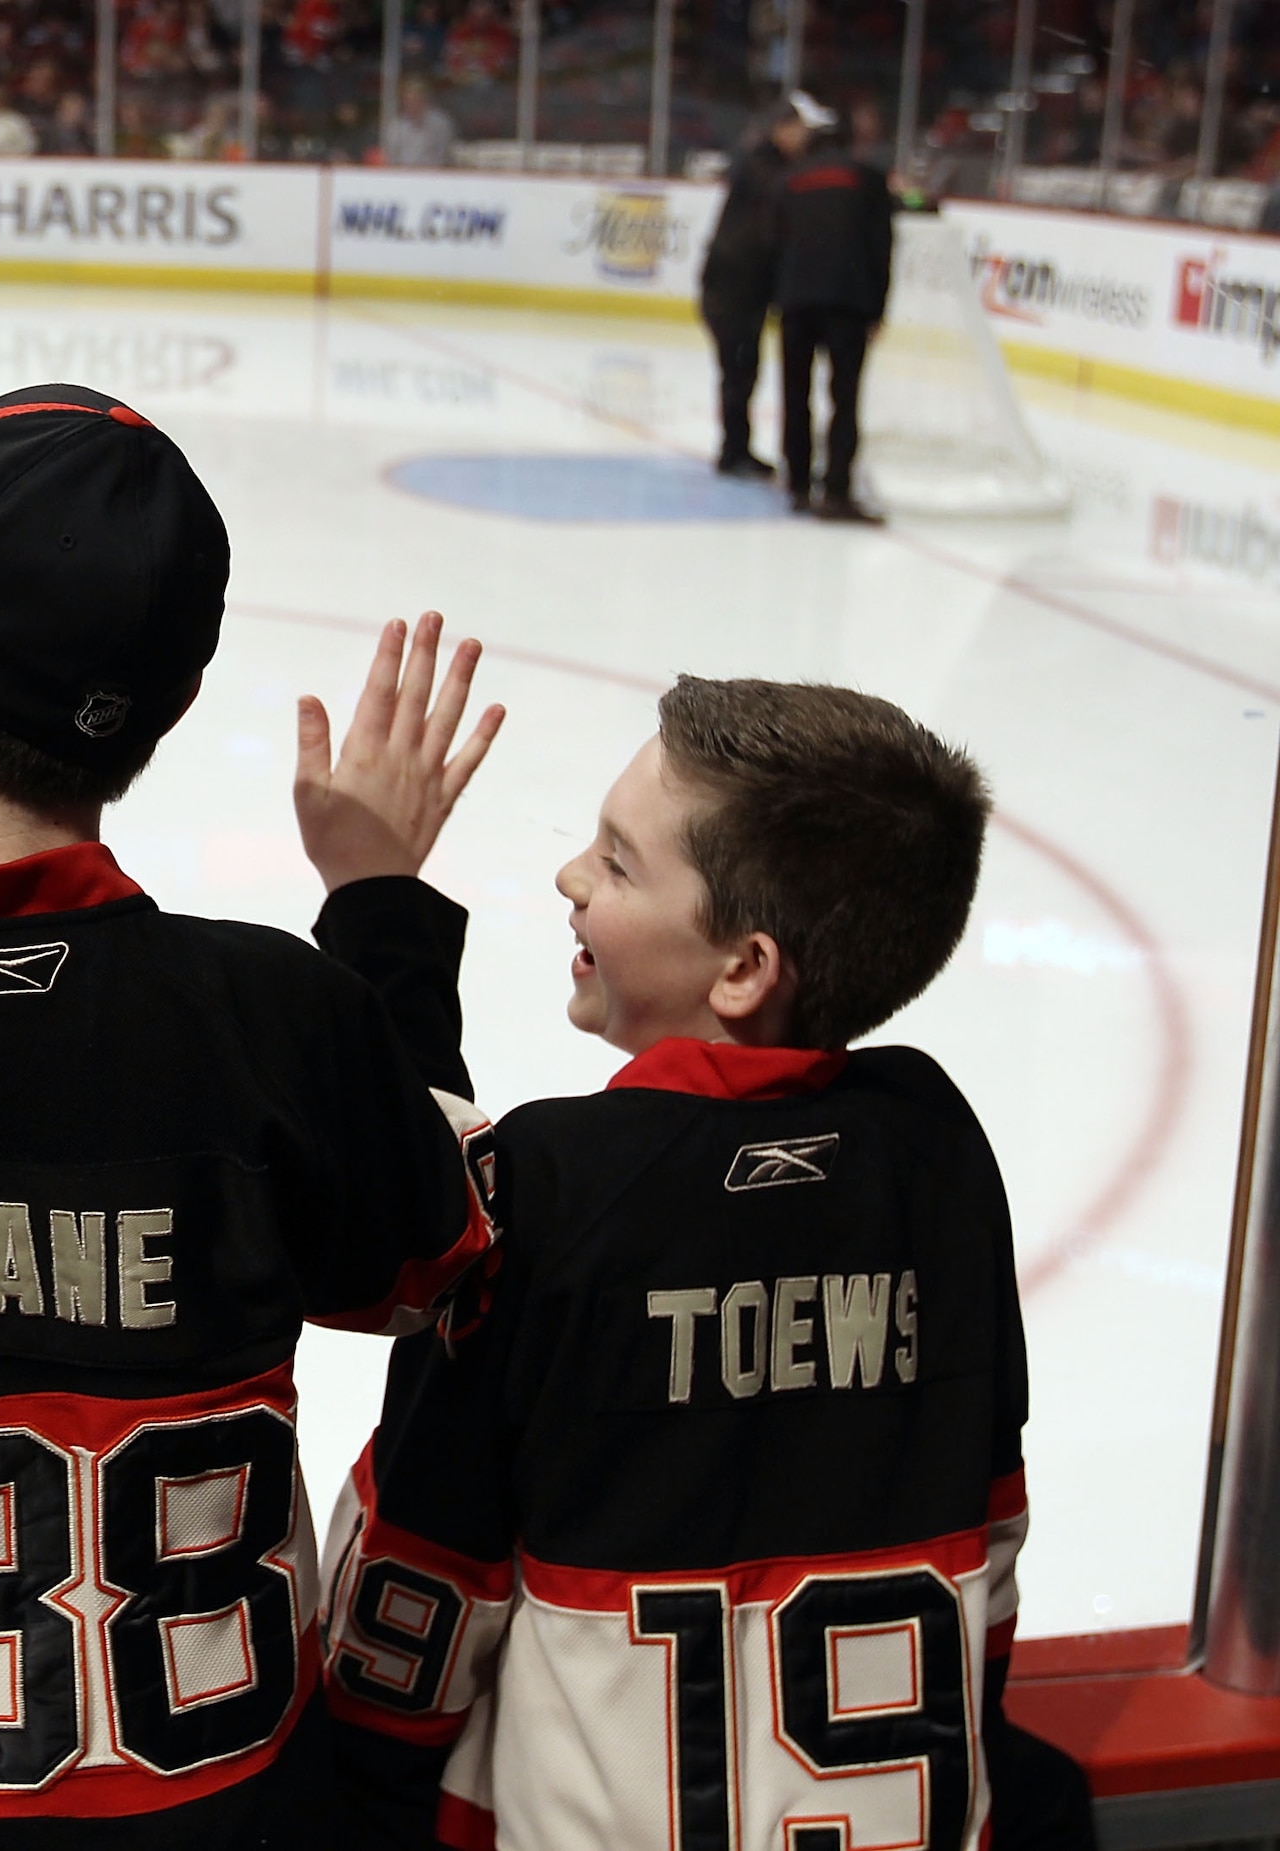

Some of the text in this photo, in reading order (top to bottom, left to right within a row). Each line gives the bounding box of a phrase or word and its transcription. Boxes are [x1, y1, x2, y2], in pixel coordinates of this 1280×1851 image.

[337, 201, 507, 246] NHL.COM
[647, 1271, 918, 1403] TOEWS
[628, 1563, 977, 1851] 19
